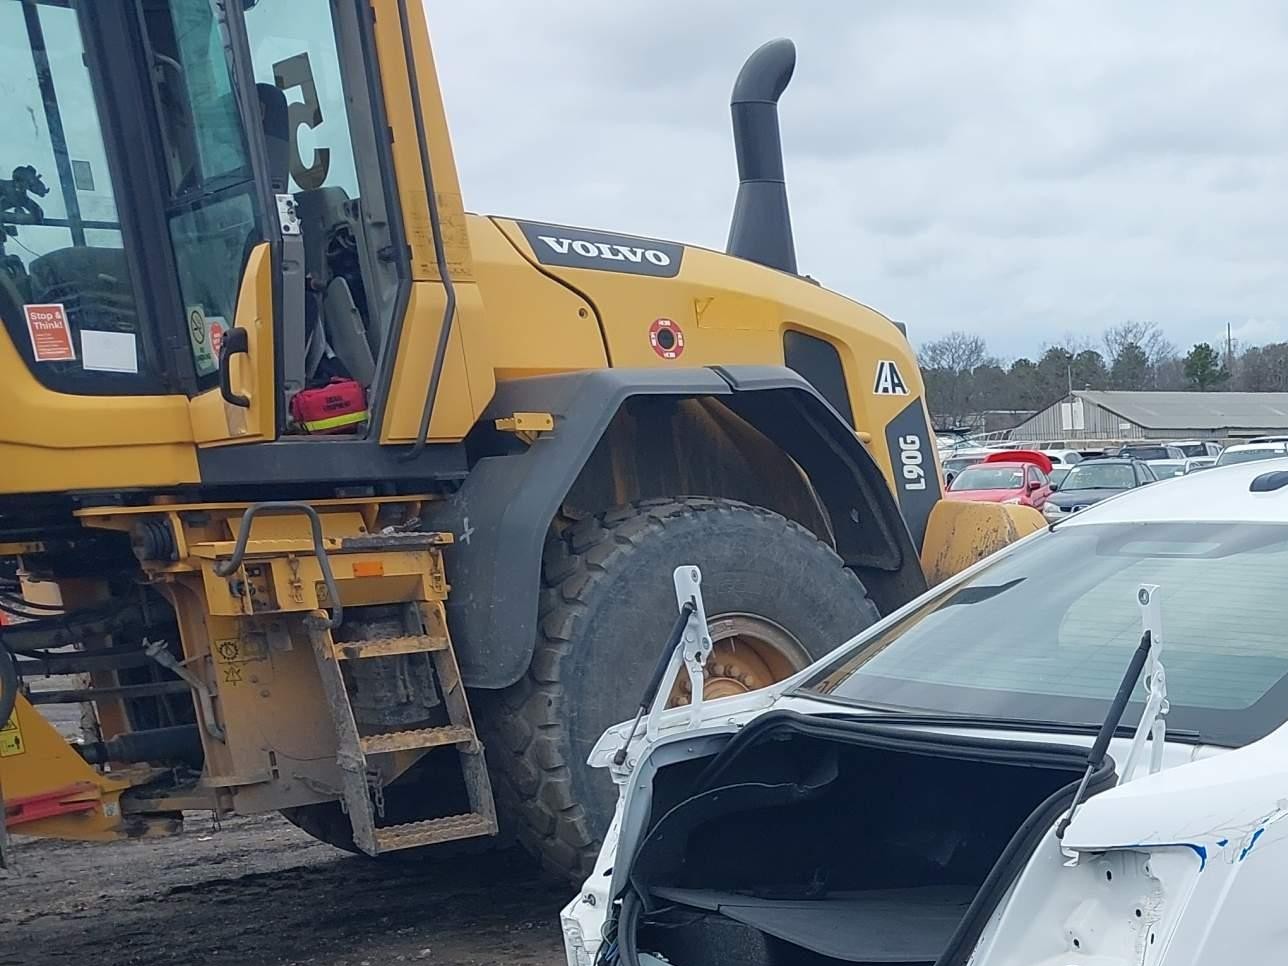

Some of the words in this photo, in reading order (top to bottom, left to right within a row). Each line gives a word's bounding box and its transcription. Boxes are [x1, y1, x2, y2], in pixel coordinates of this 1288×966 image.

[537, 235, 671, 266] VOLVO
[31, 312, 53, 320] Stop
[898, 434, 927, 491] L90G
